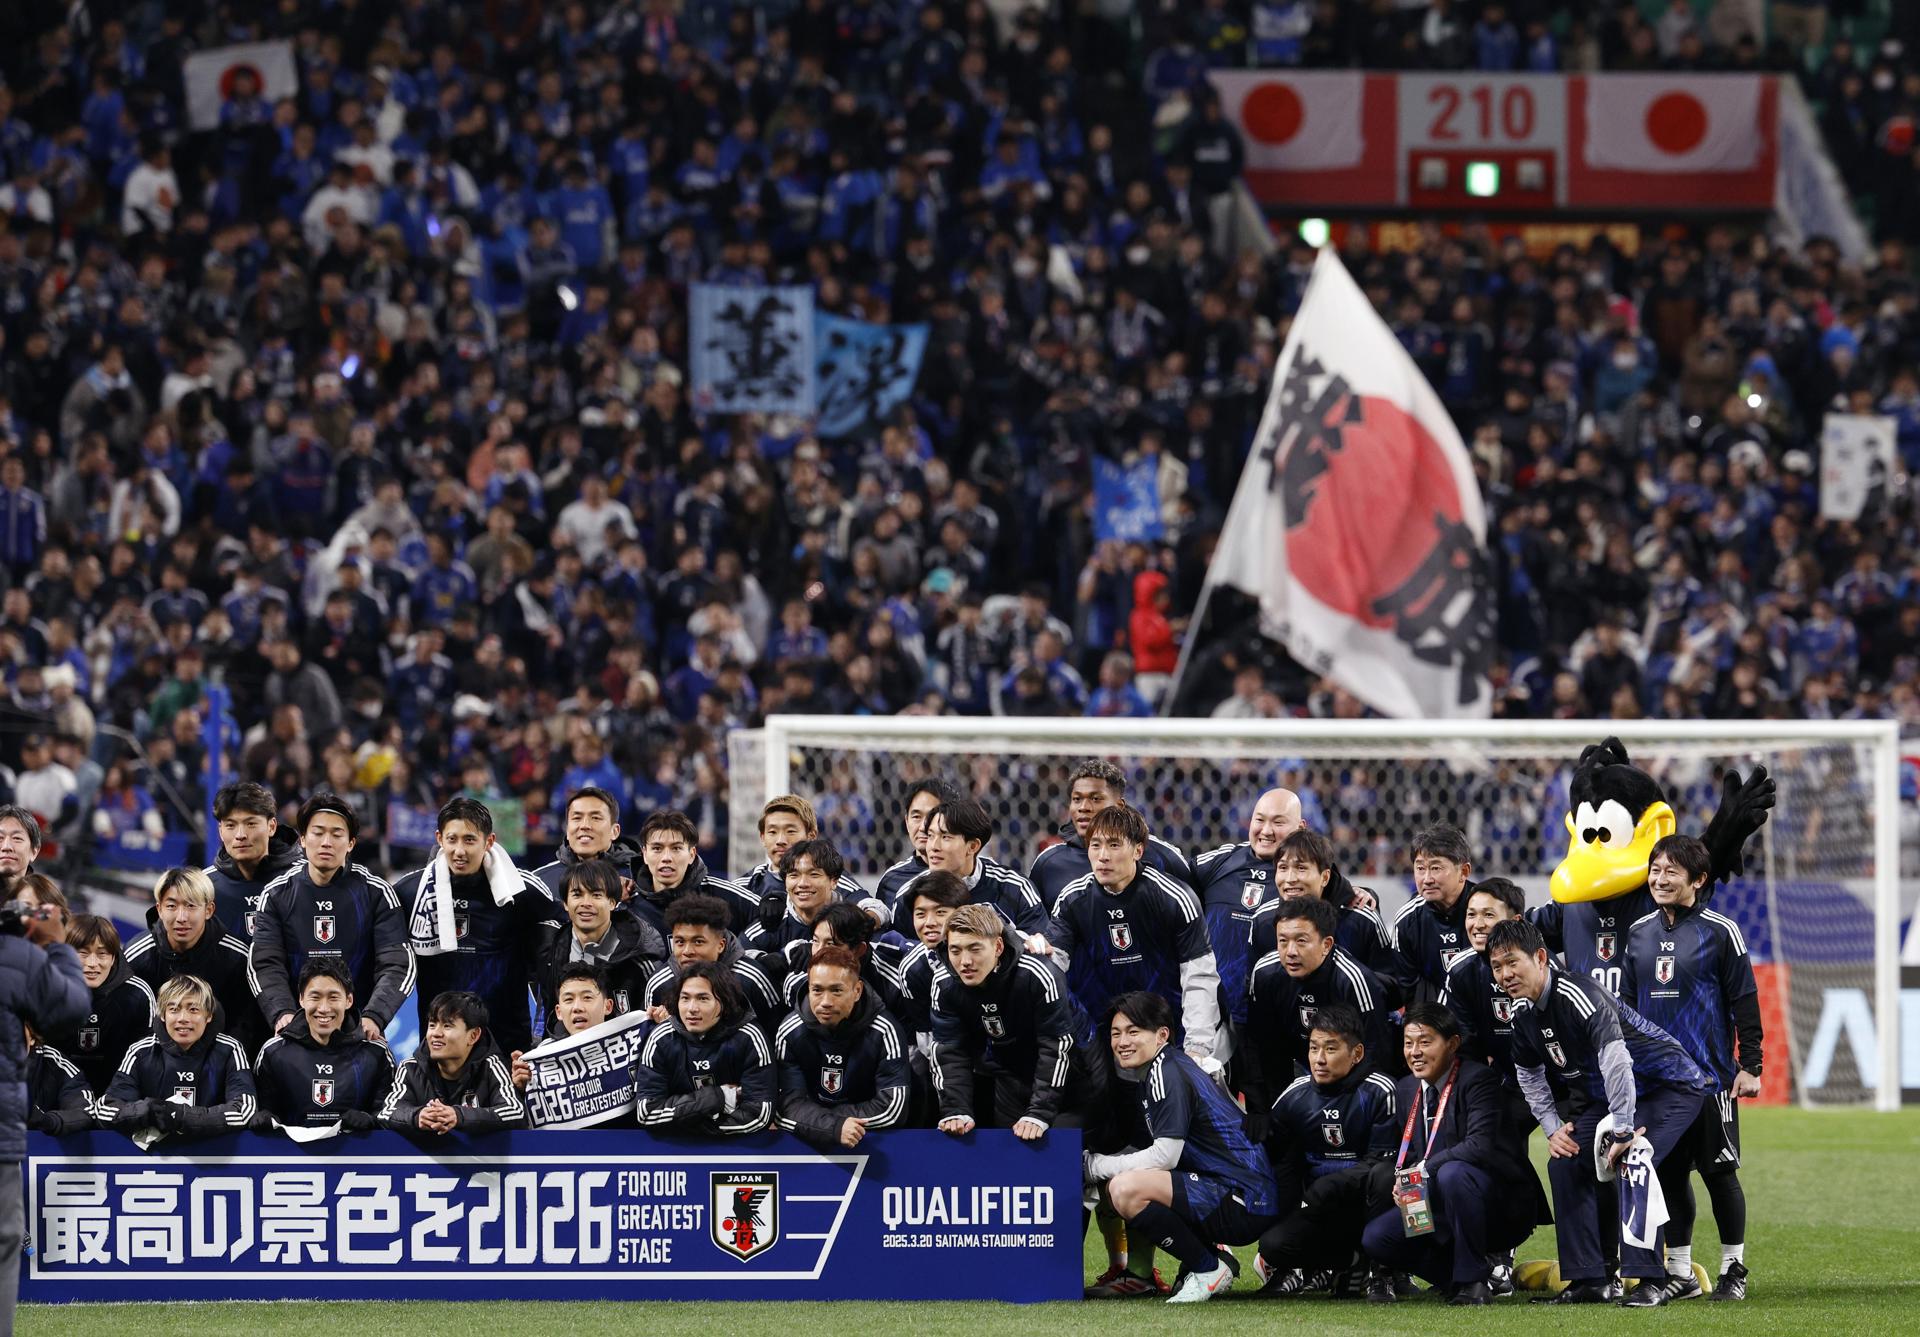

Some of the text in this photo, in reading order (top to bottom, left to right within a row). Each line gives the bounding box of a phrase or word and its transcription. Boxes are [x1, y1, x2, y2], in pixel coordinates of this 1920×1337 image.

[1427, 86, 1535, 139] 210
[1250, 869, 1267, 880] Y-3
[316, 901, 333, 911] Y-3
[1107, 909, 1125, 919] Y-3
[1599, 917, 1615, 927] Y-3
[1440, 933, 1457, 943] Y-3
[1659, 941, 1675, 952] Y-3
[1299, 994, 1315, 1003] Y-3
[981, 1003, 998, 1012] Y-3
[825, 1054, 843, 1065] Y-3
[316, 1064, 333, 1075] Y-3
[693, 1060, 710, 1071] Y-3
[177, 1071, 195, 1082] Y-3
[569, 1078, 603, 1099] FOR OUR
[573, 1085, 633, 1117] GREATEST STAGE
[1323, 1109, 1340, 1120] Y-3
[618, 1171, 687, 1197] FOR OUR
[727, 1175, 762, 1183] JAPAN
[882, 1186, 1054, 1231] QUALIFIED
[618, 1204, 704, 1231] GREATEST
[730, 1232, 760, 1246] JFA
[883, 1234, 1054, 1248] 2025.3.20 SAITAMA STADIUM 2002
[618, 1238, 673, 1264] STAGE
